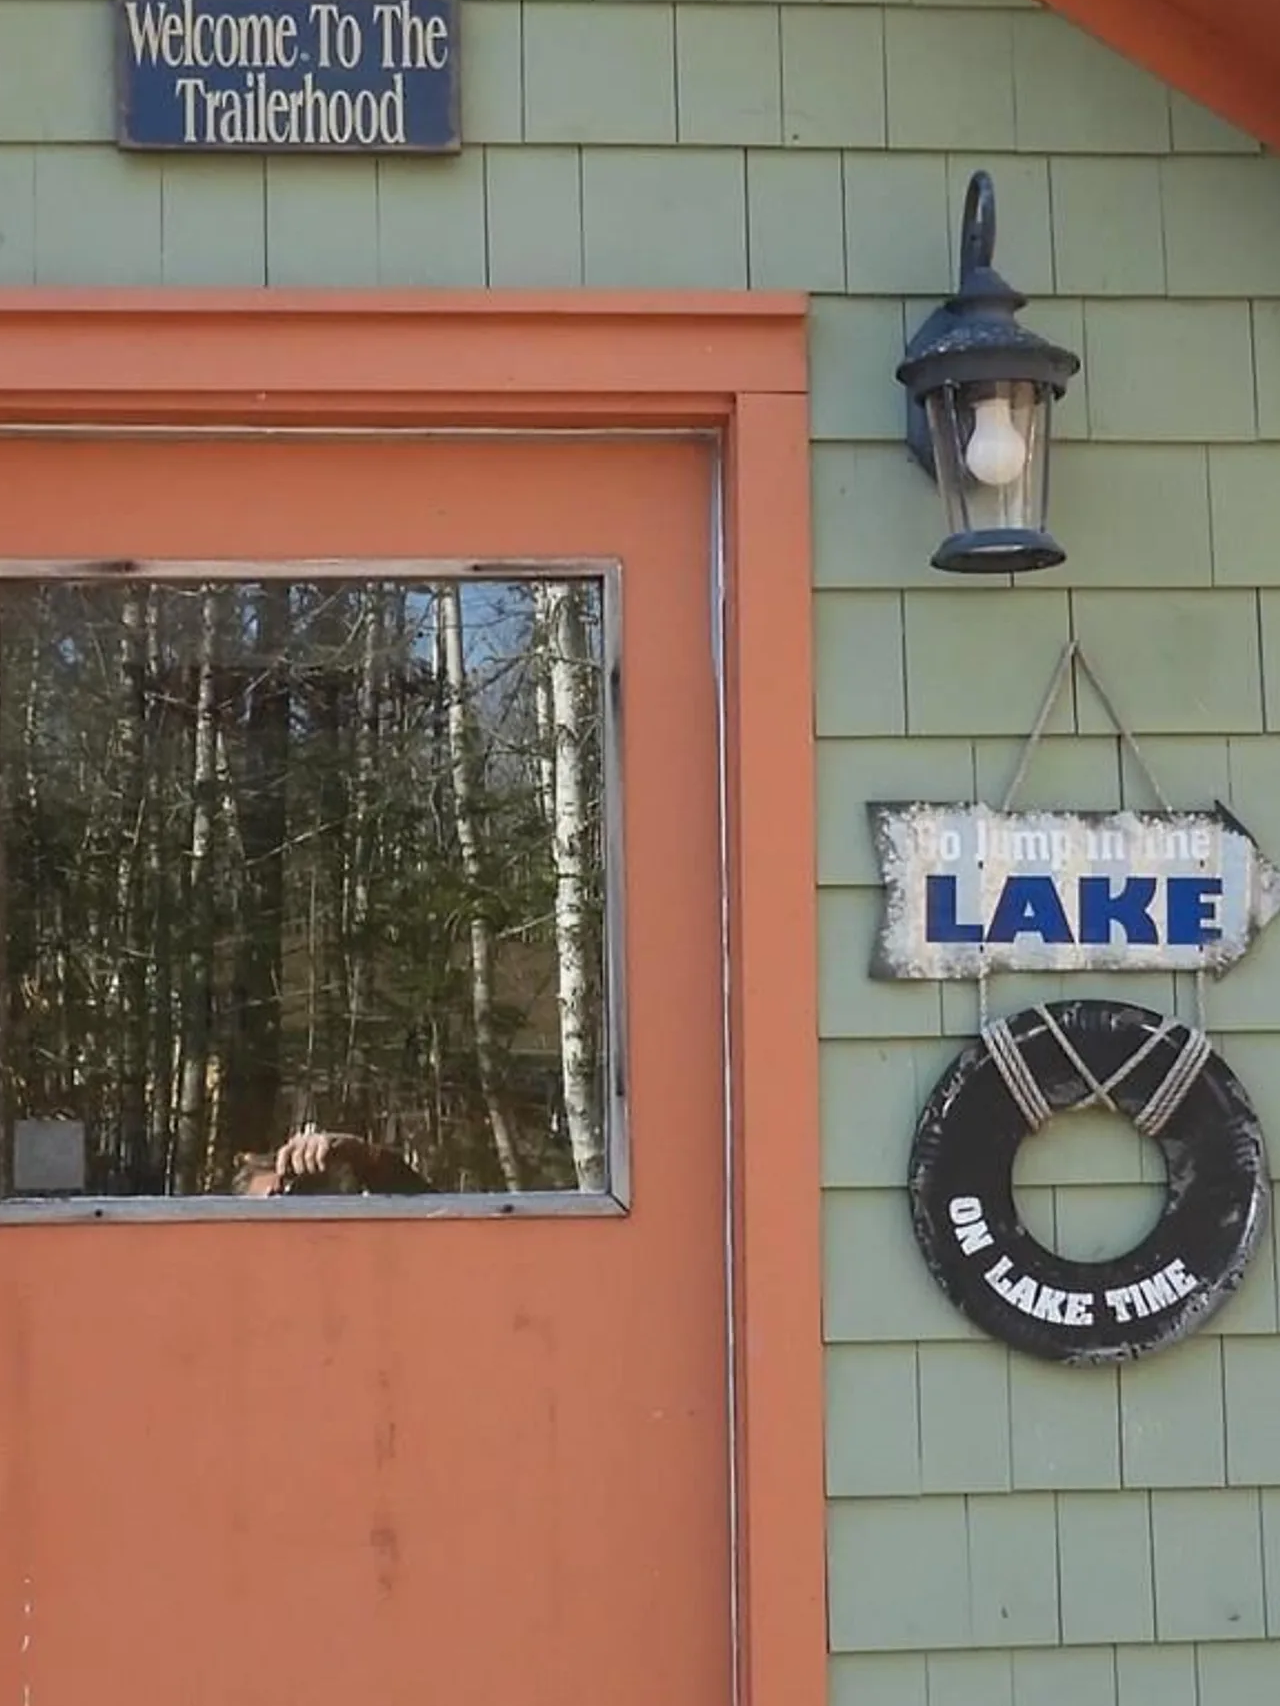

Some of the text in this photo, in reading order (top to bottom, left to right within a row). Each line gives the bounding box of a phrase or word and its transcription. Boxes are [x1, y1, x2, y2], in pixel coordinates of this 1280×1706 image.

[309, 3, 363, 70] To
[176, 72, 407, 144] Trailerhood
[926, 875, 1223, 945] LAKE
[949, 1196, 1198, 1326] ON LAKE TIME
